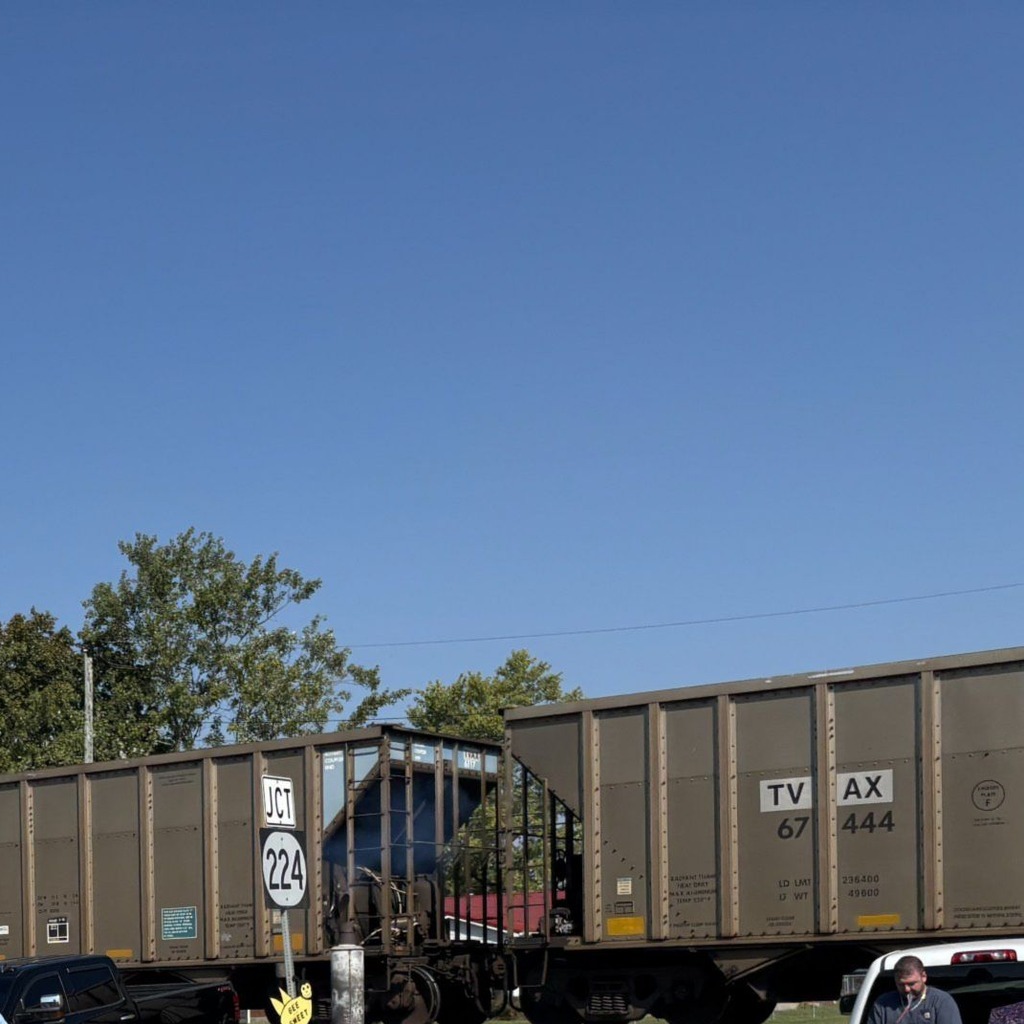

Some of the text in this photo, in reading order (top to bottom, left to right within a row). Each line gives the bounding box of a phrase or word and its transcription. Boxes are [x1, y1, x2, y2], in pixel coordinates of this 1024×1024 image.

[266, 786, 291, 819] JCT
[767, 775, 883, 806] TV AX
[777, 810, 895, 839] 67 444
[266, 848, 303, 890] 224
